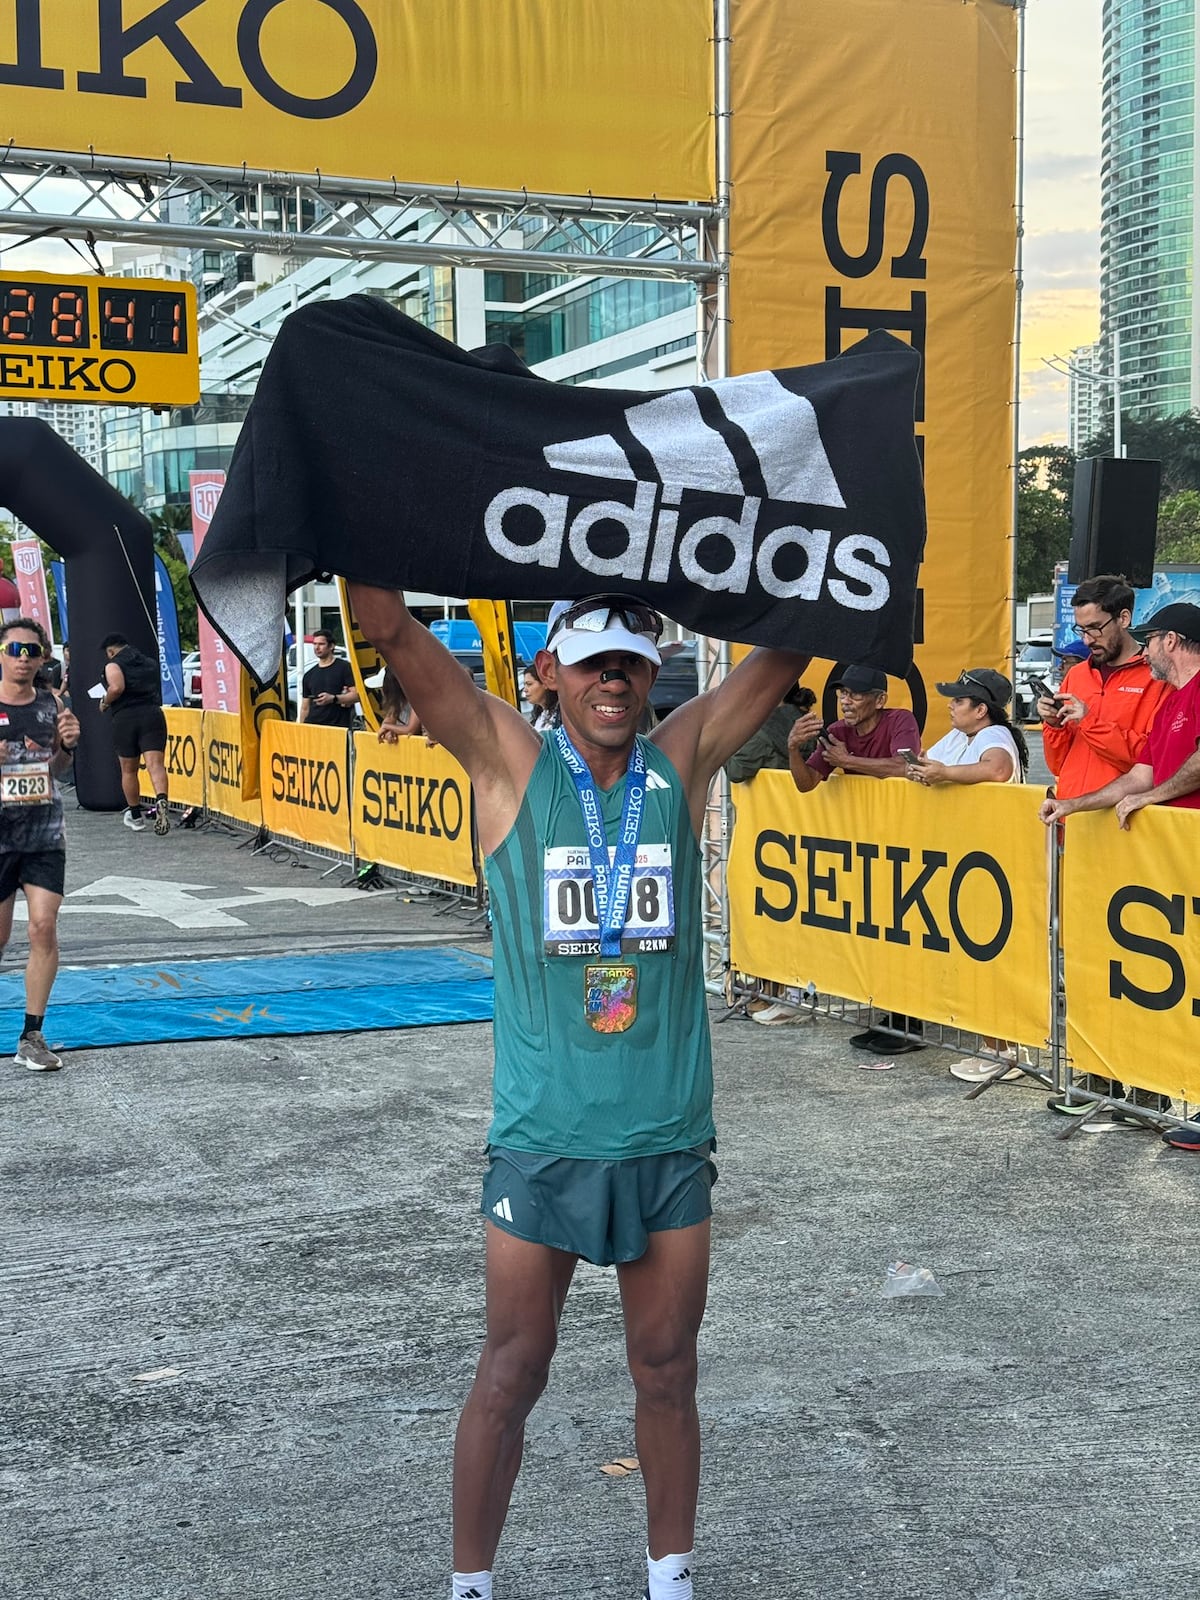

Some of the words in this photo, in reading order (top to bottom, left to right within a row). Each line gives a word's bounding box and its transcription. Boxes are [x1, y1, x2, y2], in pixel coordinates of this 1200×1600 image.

[484, 480, 892, 612] adidas
[7, 776, 46, 796] 2623
[271, 752, 341, 815] SEIKO
[362, 769, 463, 841] SEIKO
[623, 786, 643, 844] SEIKO
[581, 789, 603, 848] SEIKO
[754, 829, 1013, 962] SEIKO
[558, 942, 601, 956] SEIK
[639, 939, 668, 951] 42KM
[1107, 885, 1200, 1018] S
